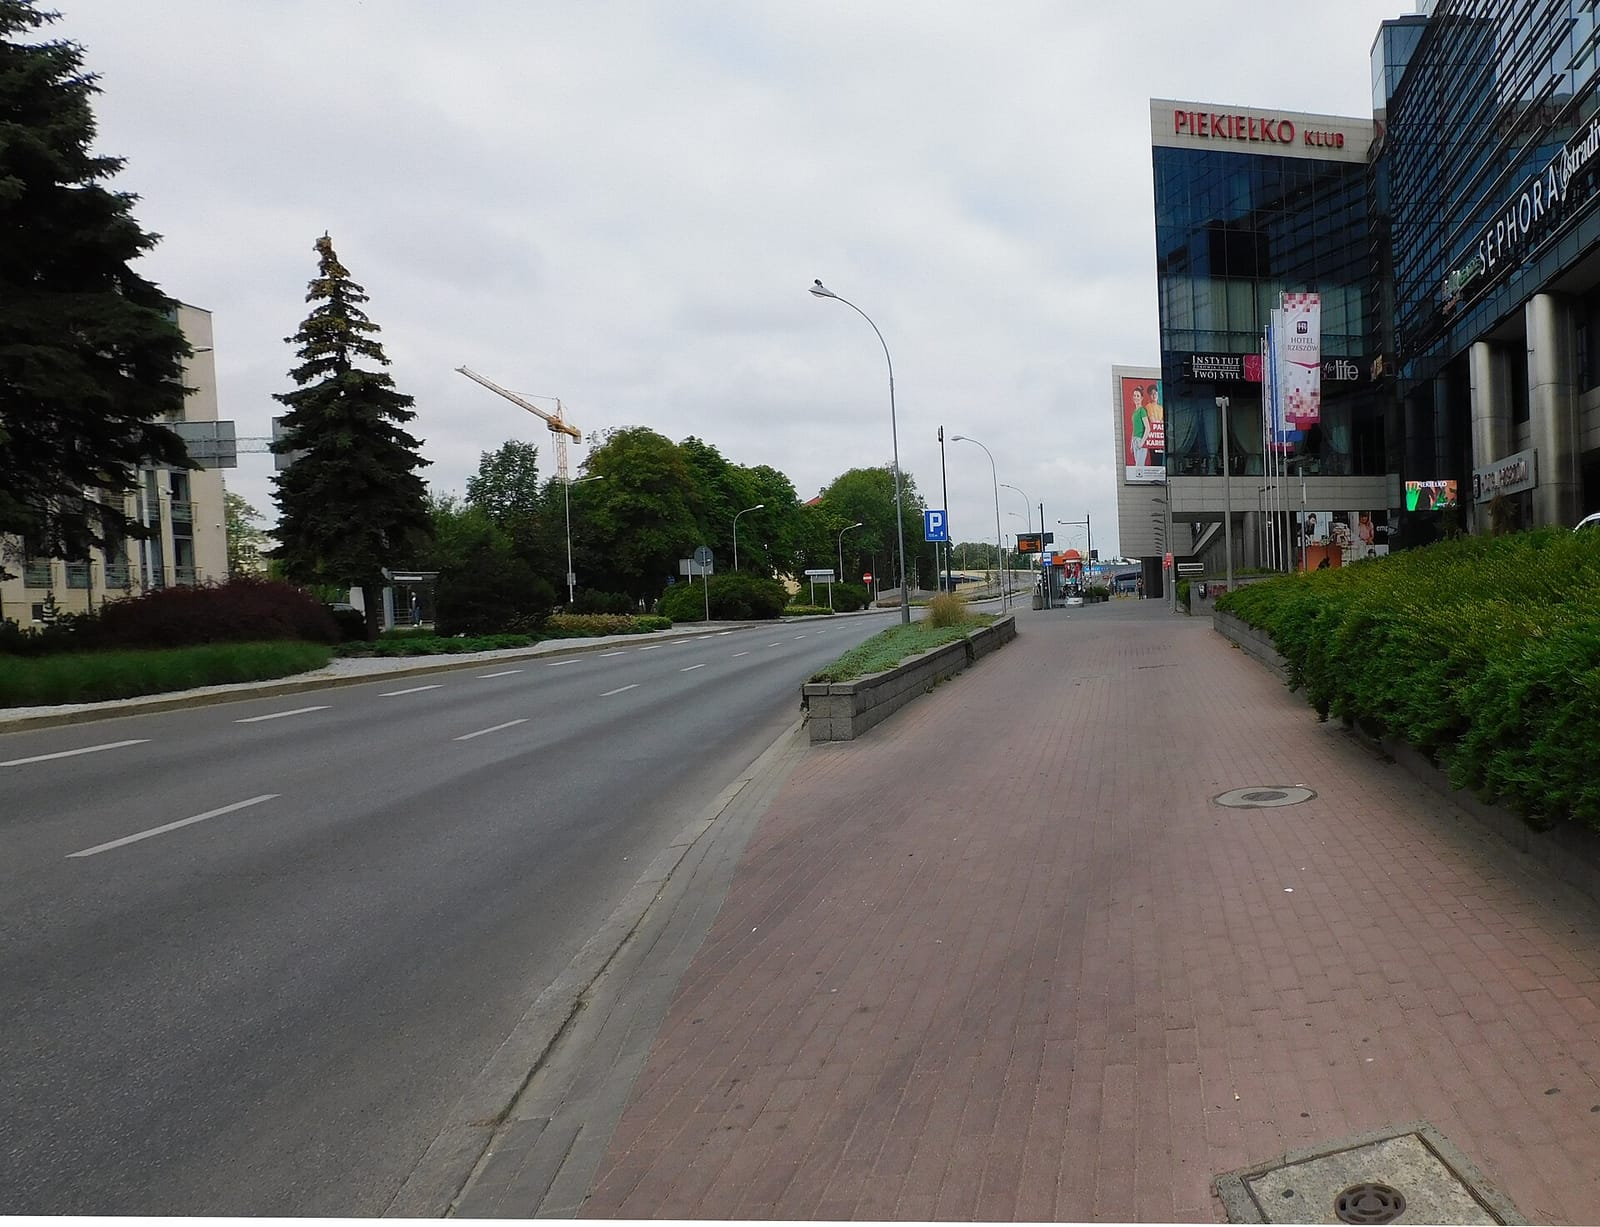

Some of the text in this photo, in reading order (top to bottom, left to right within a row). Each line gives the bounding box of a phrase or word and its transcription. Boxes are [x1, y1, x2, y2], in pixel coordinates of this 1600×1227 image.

[1174, 110, 1345, 148] PIEKIEŁKO KLUB
[1479, 165, 1559, 275] SEPHORA
[1192, 355, 1240, 365] INSTYTUT
[1335, 360, 1359, 381] life
[929, 512, 942, 532] P
